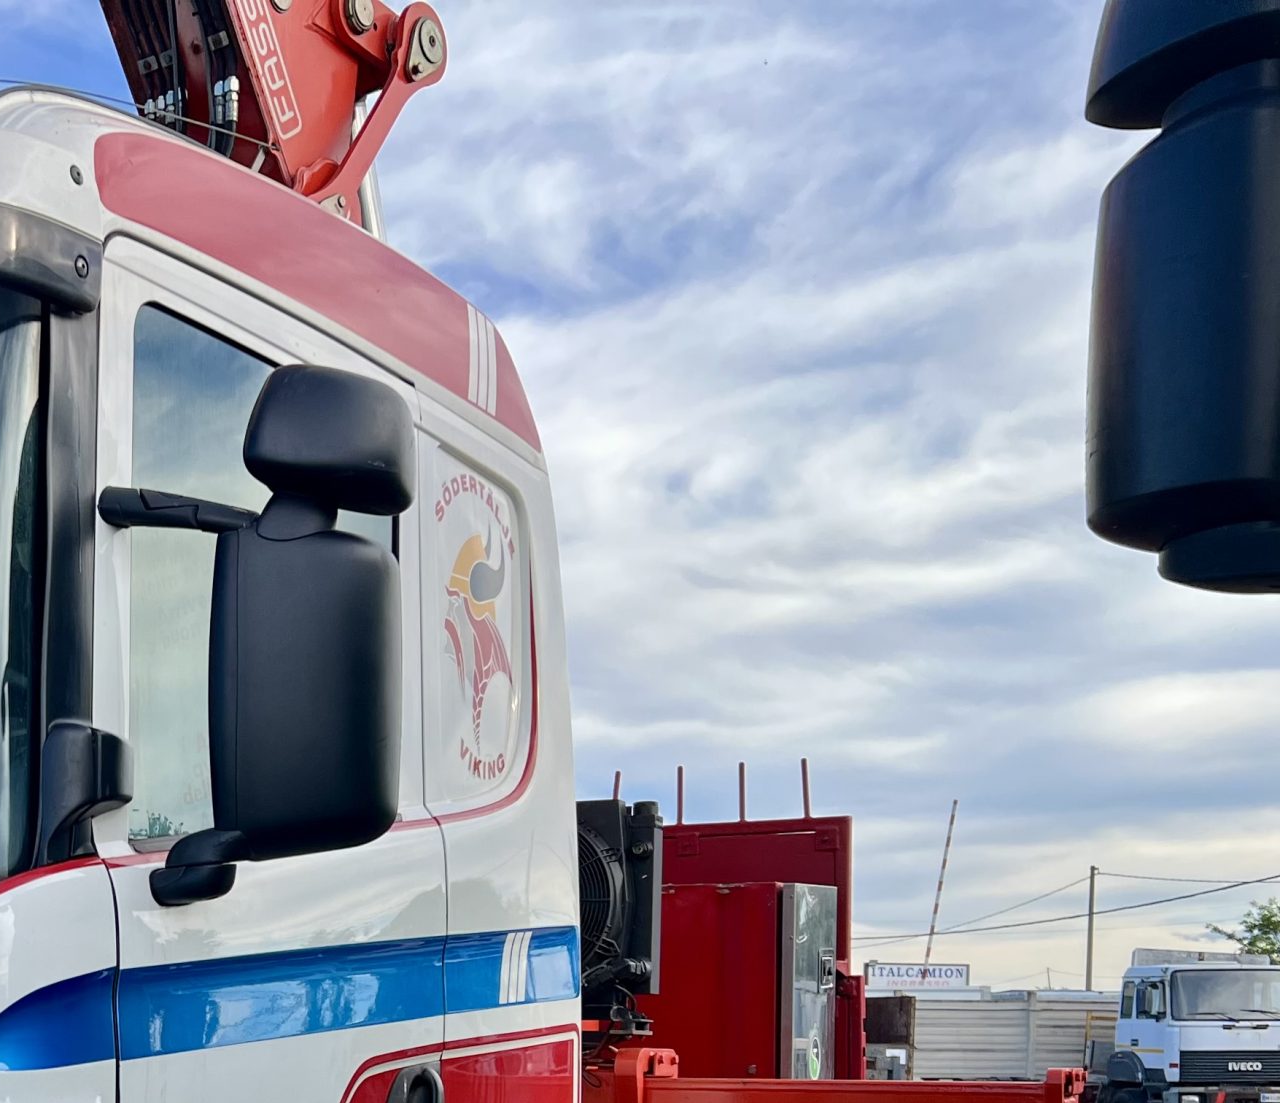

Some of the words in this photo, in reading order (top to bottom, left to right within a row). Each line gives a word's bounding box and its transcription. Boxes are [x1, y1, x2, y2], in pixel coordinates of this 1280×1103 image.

[435, 473, 515, 560] SÖDERTÄLJE
[460, 736, 505, 780] VIKING
[871, 966, 964, 979] ITALCAMION
[1227, 1061, 1262, 1072] IVECO
